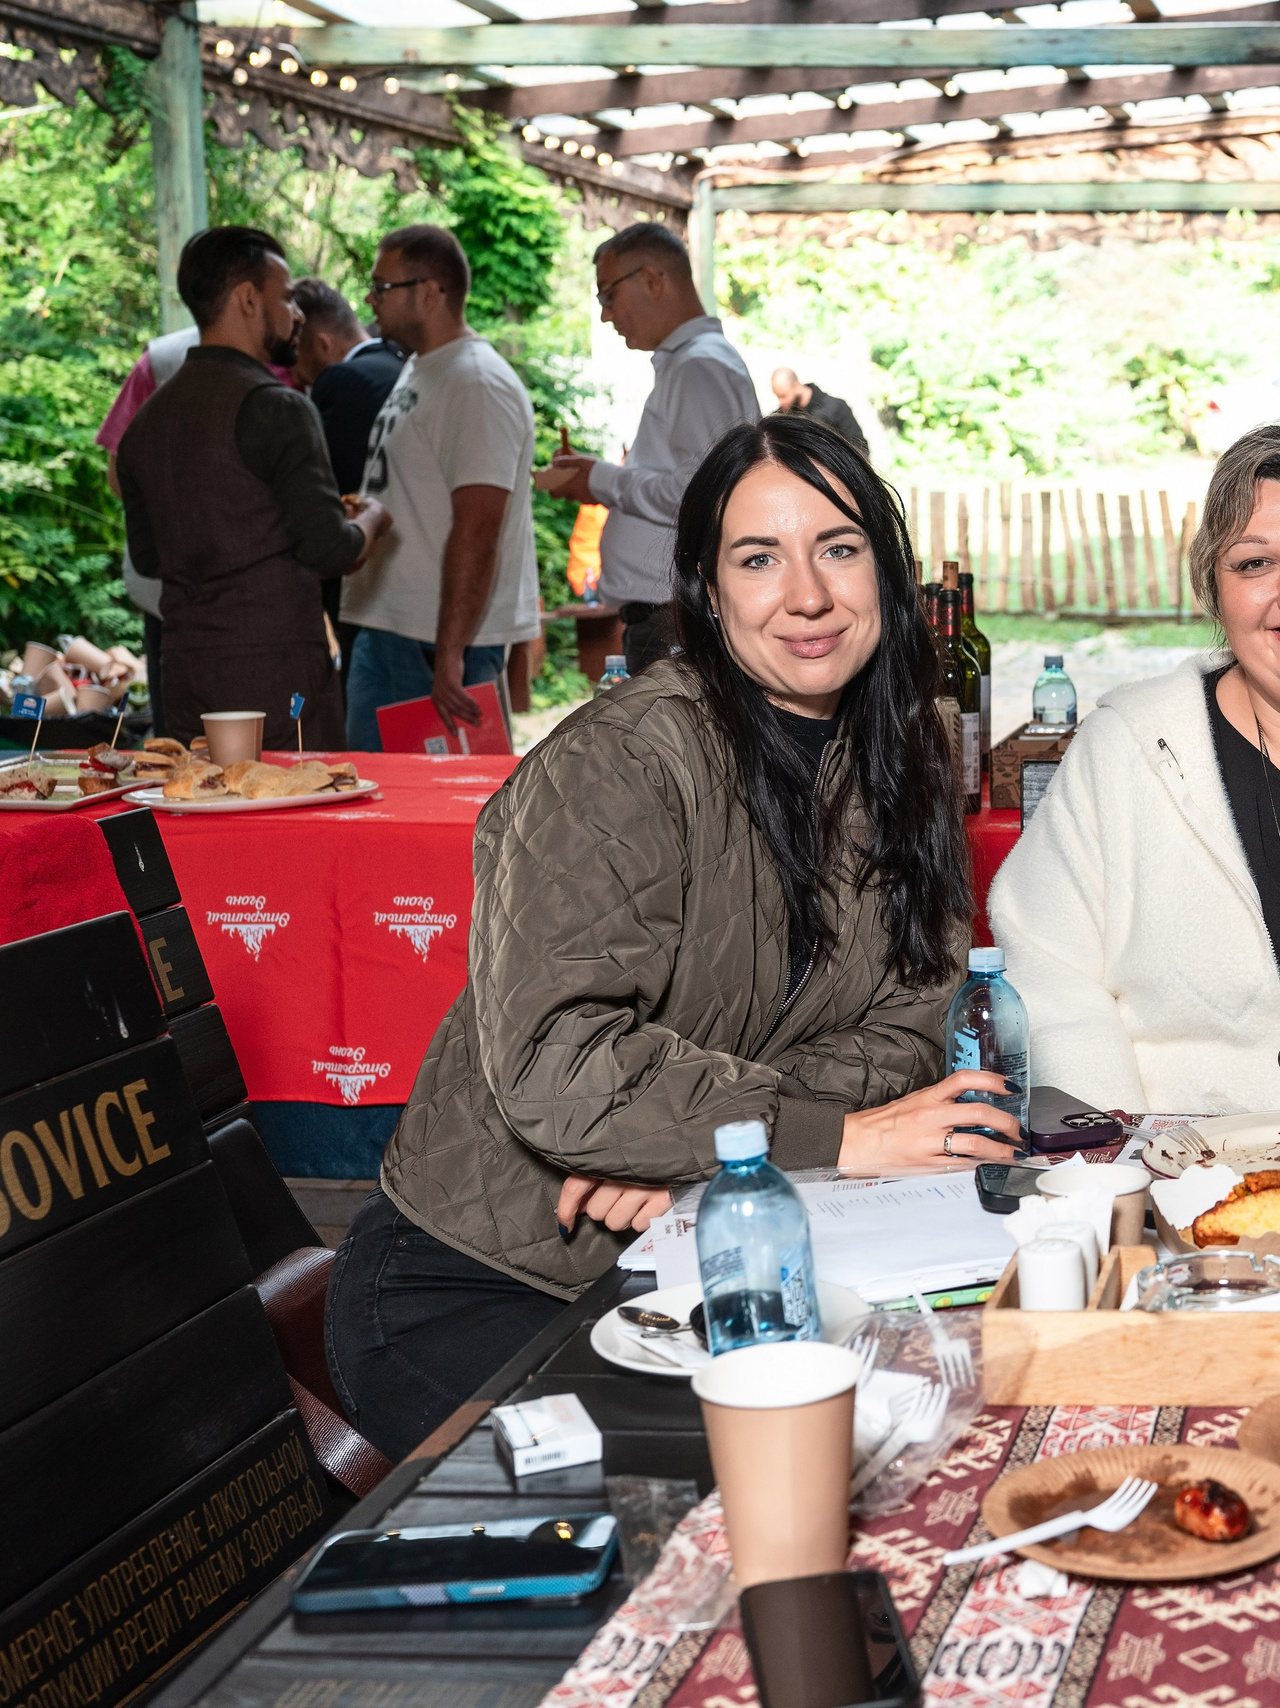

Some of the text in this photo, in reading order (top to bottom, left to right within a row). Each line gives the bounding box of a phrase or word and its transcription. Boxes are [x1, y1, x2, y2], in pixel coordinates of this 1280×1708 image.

[74, 1510, 208, 1636] УПОТРЕБЛЕНИЕ
[200, 1430, 309, 1541] АЛКОГОЛЬНОЙ
[116, 1587, 182, 1672] ВРЕДИТ
[177, 1536, 247, 1621] ВАШЕМУ
[243, 1479, 324, 1568] ЗДОРОВЬЮ
